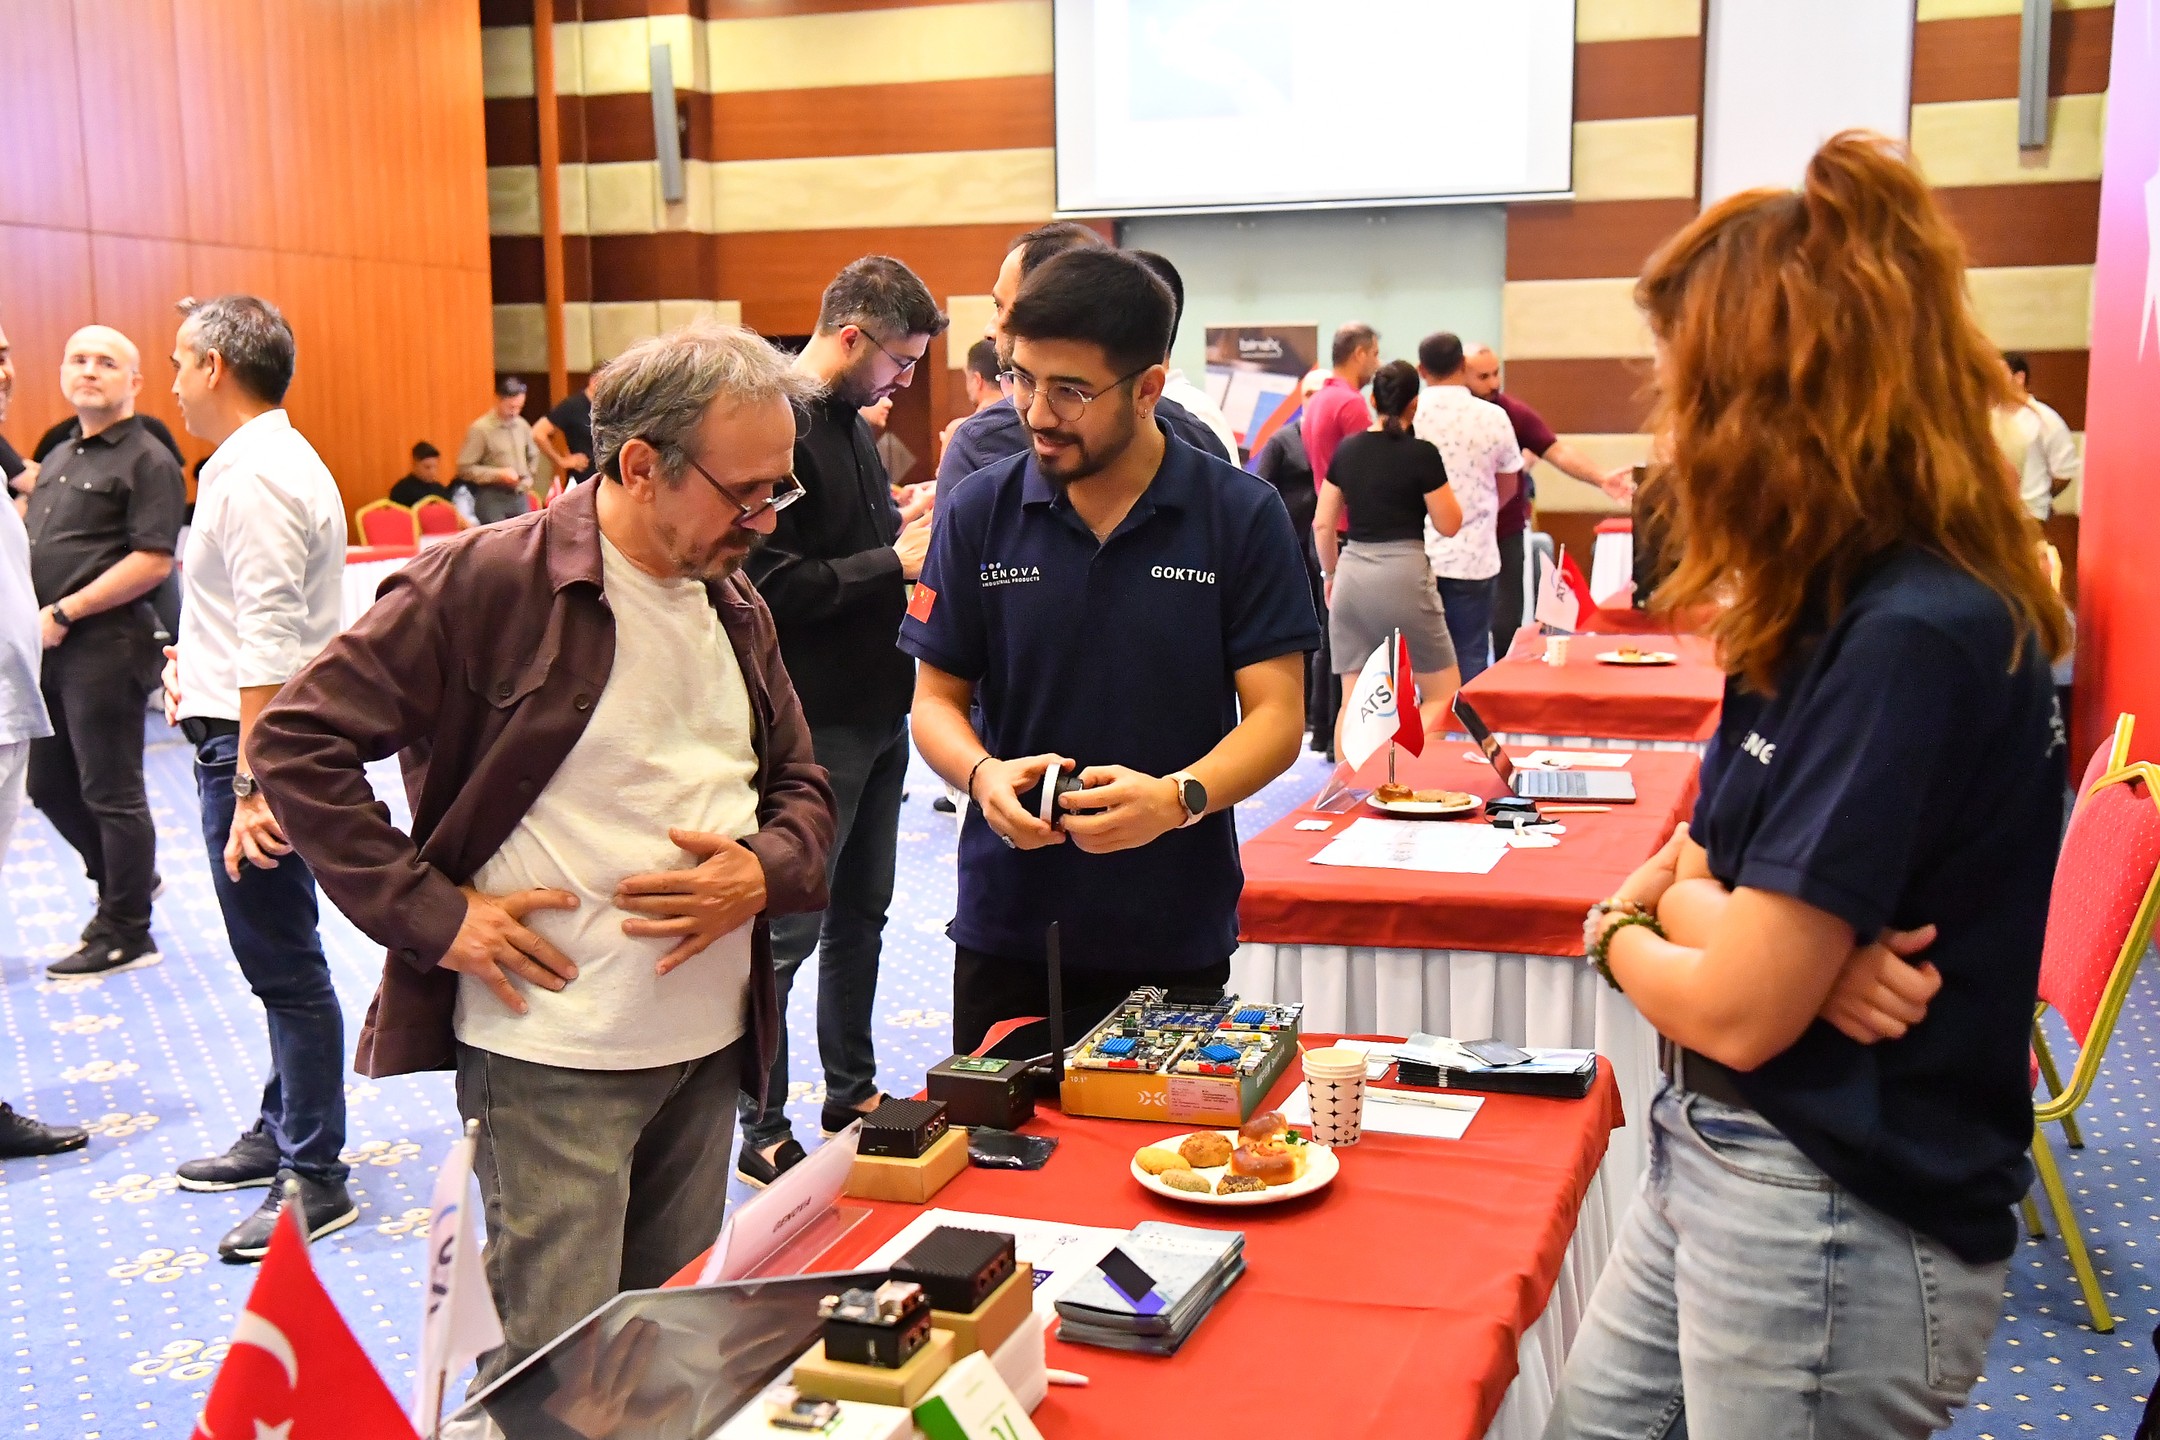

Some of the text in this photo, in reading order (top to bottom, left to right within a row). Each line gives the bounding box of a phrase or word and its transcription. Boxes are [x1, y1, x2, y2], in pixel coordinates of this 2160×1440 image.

[980, 566, 1040, 581] GENOVA
[1151, 565, 1216, 585] GOKTUG
[1361, 685, 1392, 723] ATS
